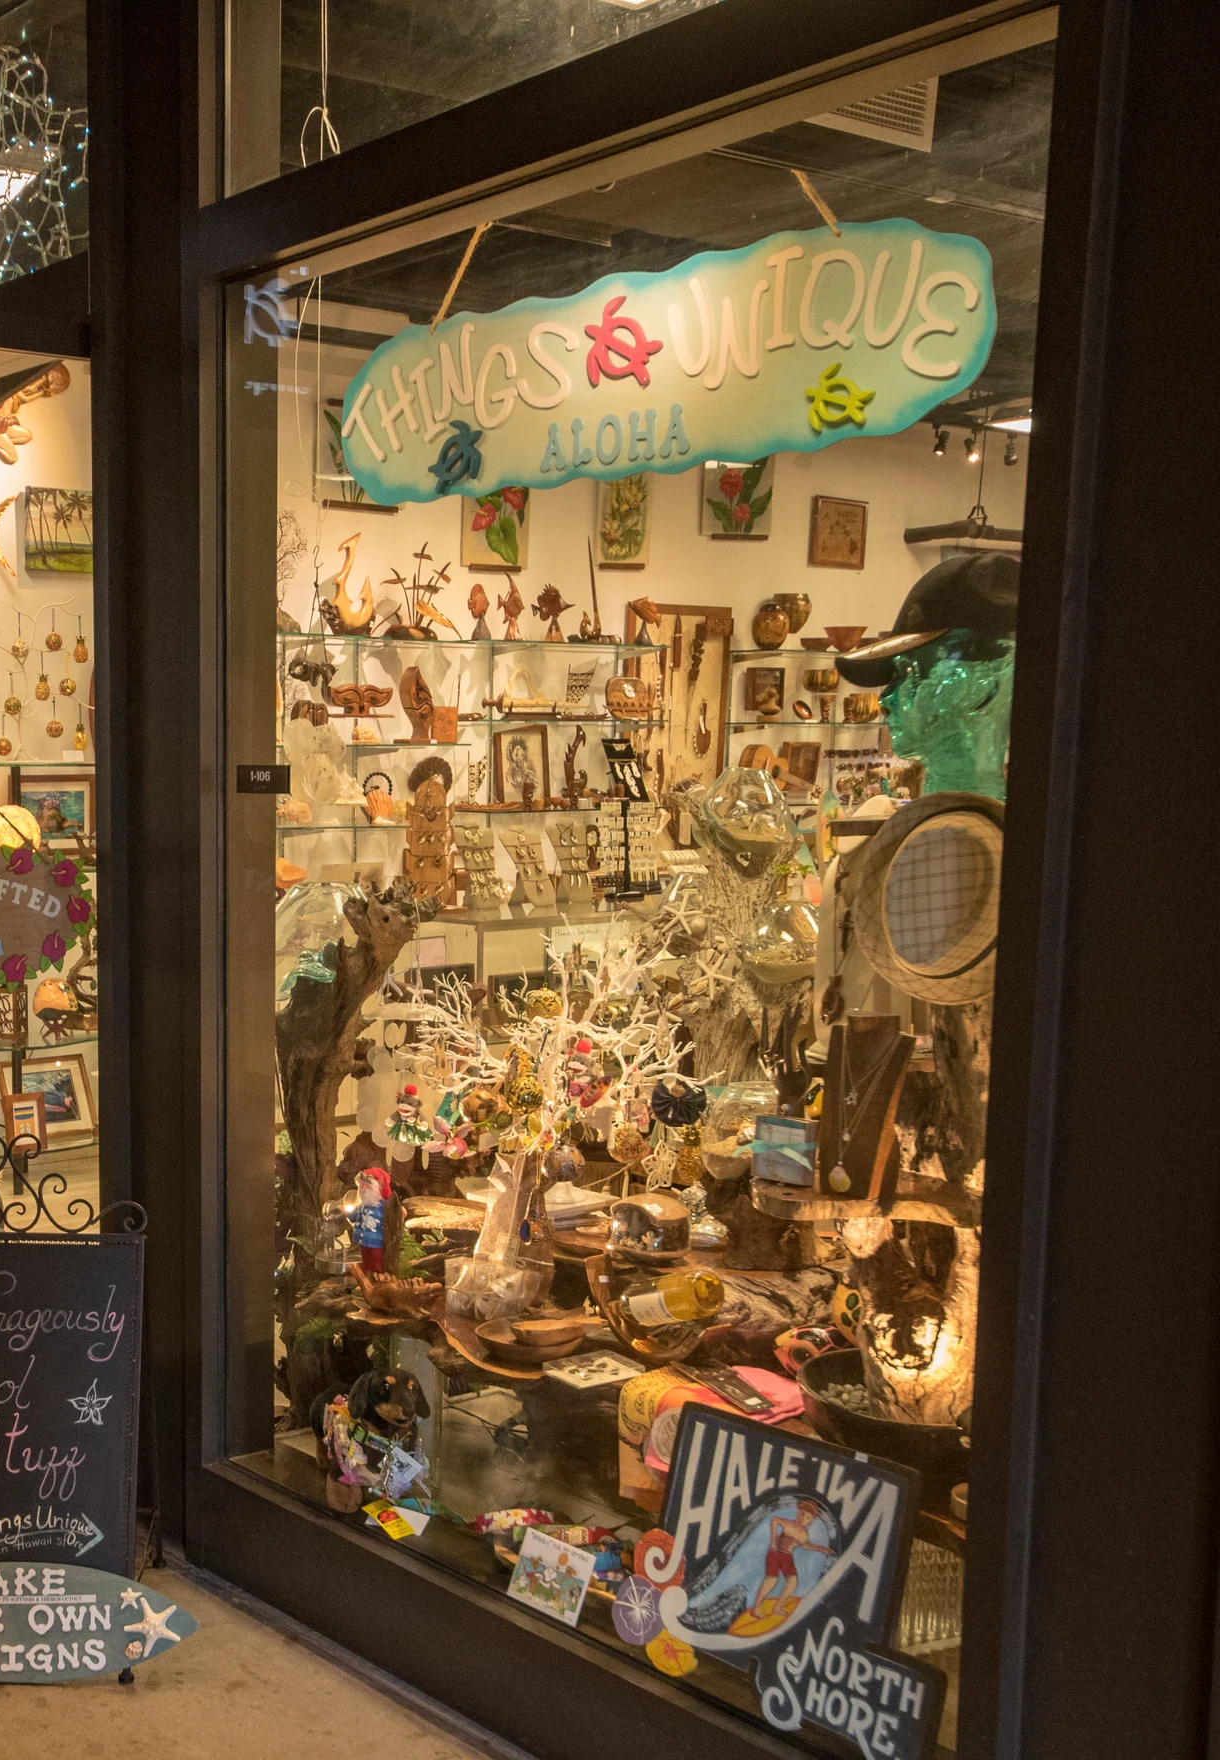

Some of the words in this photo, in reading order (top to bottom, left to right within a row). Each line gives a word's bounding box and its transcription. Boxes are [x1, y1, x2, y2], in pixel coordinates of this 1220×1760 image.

[342, 319, 581, 463] THINGS
[667, 238, 980, 390] UNIQUE
[540, 403, 691, 474] ALOHA
[16, 1536, 53, 1550] Hawaii
[36, 1505, 95, 1540] Unique
[27, 1602, 112, 1634] OWN
[788, 1617, 926, 1720] NORTH
